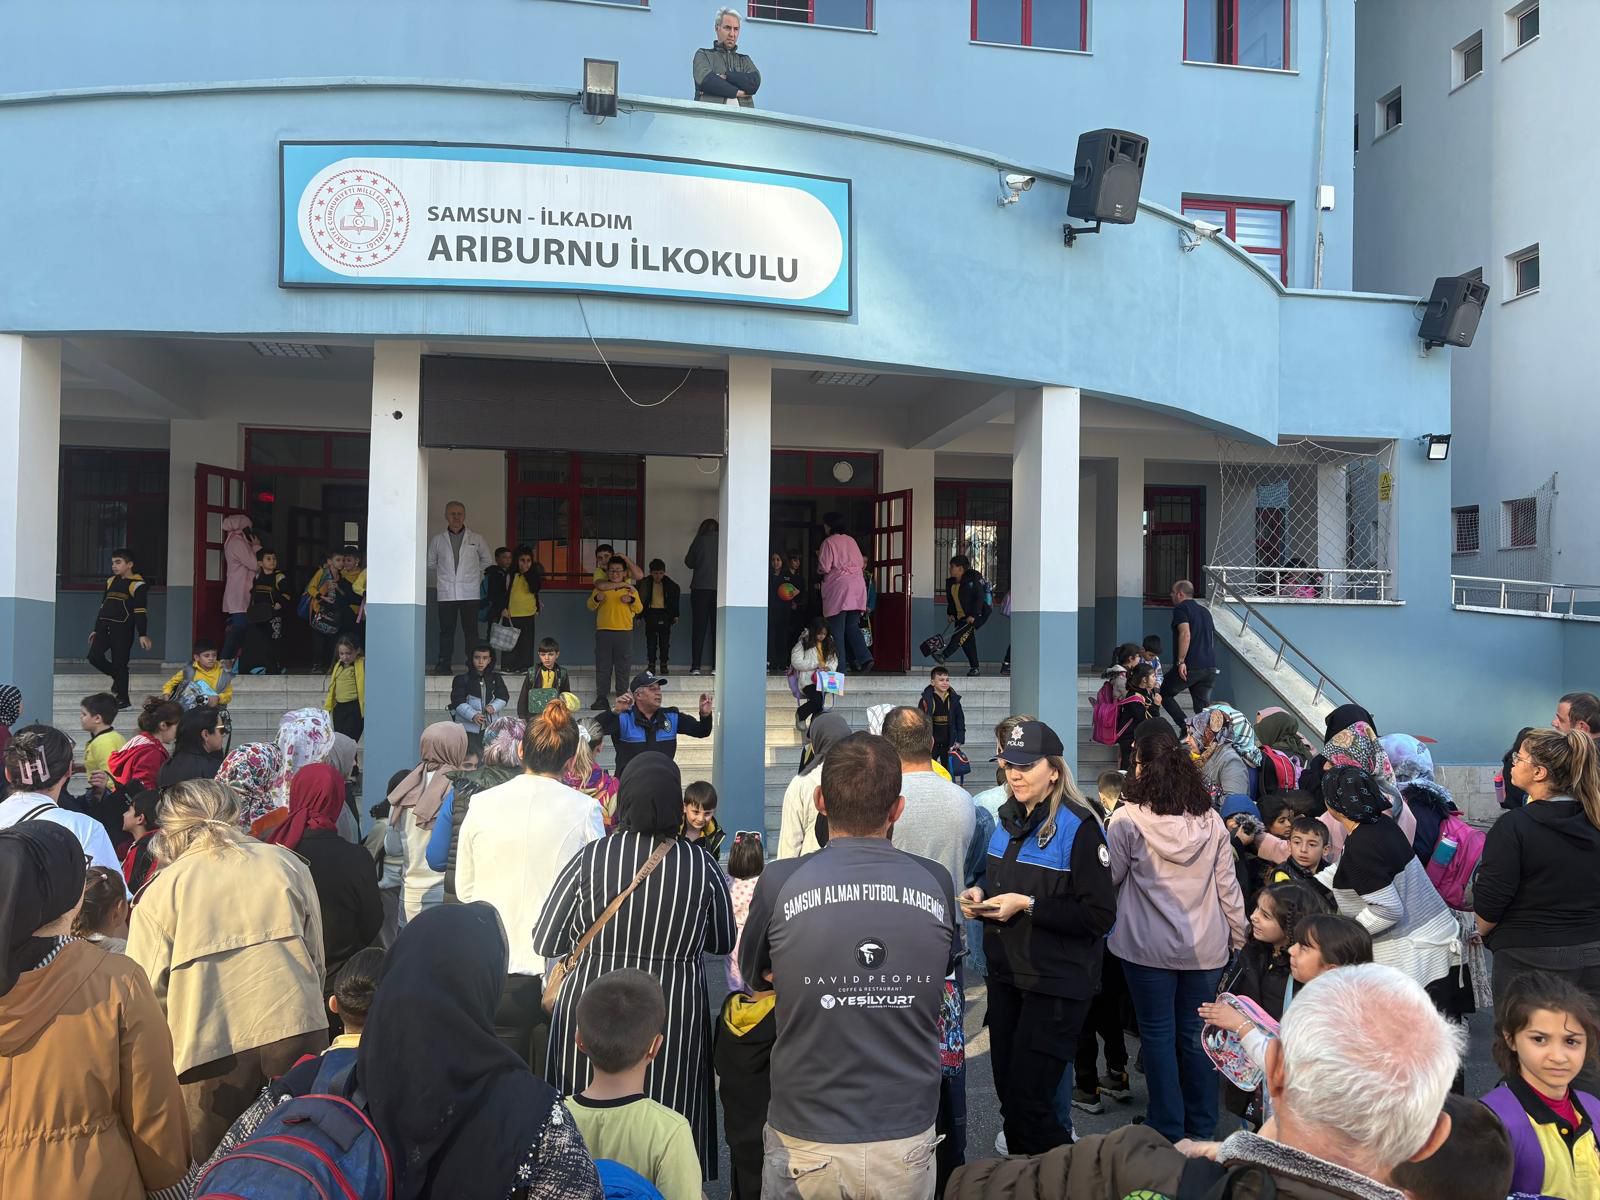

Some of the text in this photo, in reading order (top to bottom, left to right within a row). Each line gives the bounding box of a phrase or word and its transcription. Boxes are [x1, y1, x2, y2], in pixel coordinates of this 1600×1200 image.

[356, 187, 376, 196] MİLLİ
[427, 206, 522, 225] SAMSUN
[541, 206, 632, 231] İLKADIM
[427, 234, 799, 283] ARIBURNU İLKOKULU
[783, 887, 821, 921] SAMSUN
[824, 883, 860, 905] ALMAN
[862, 883, 900, 903] FUTBOL
[804, 974, 932, 985] DAVID PEOPLE
[836, 992, 916, 1008] YEŞİLYURT
